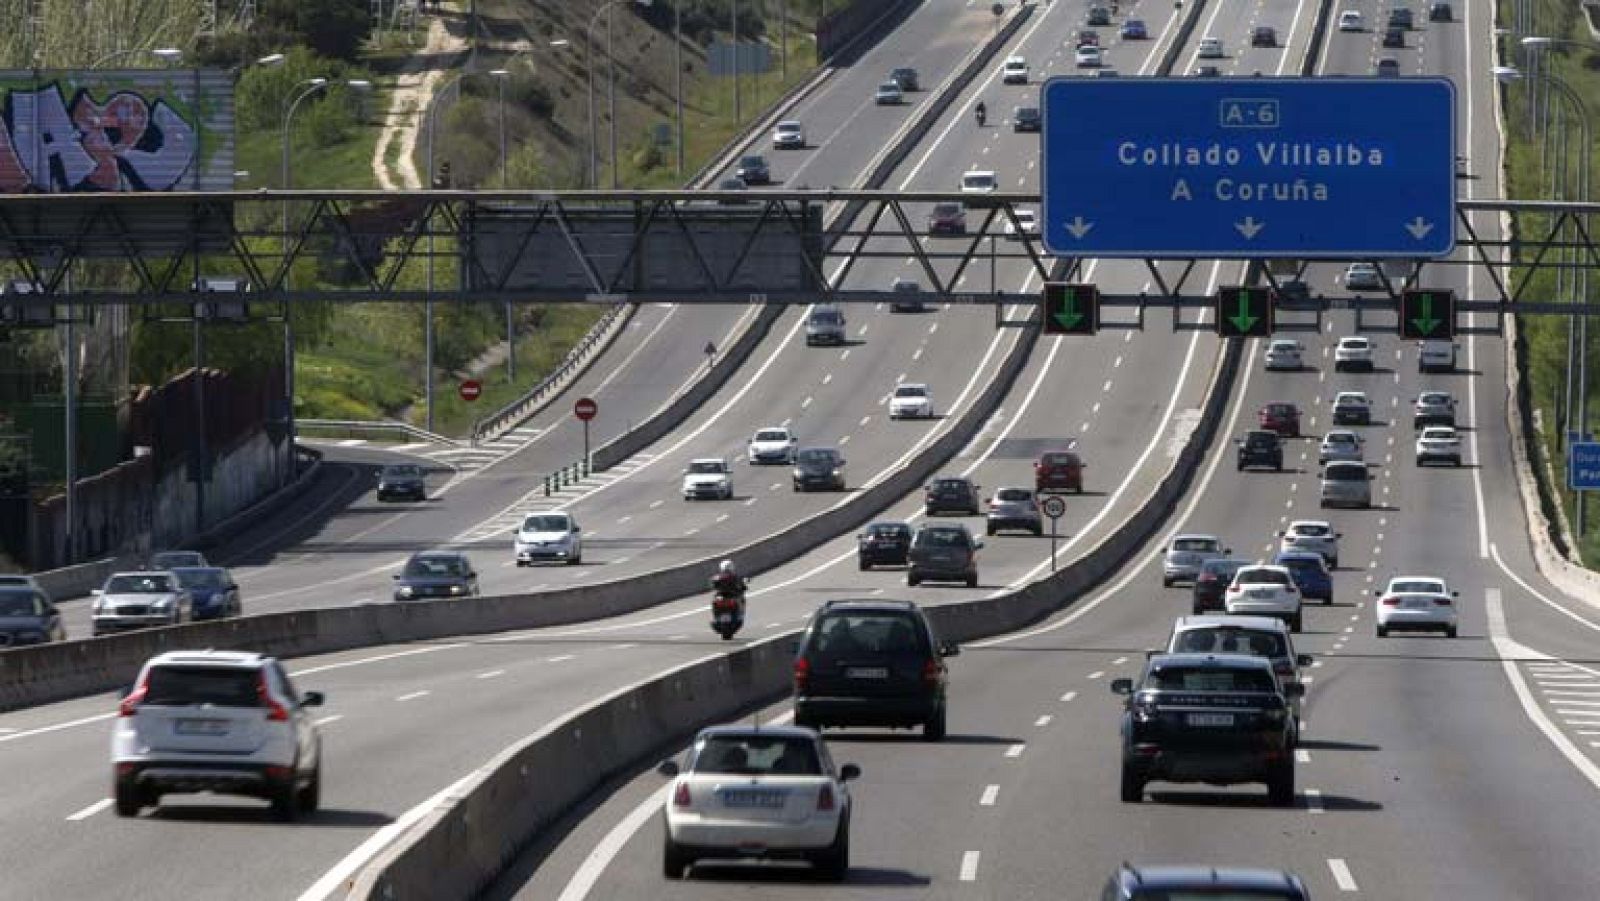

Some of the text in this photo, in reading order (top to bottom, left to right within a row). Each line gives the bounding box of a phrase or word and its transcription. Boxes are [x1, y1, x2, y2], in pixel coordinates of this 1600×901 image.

[1226, 103, 1274, 122] A-6
[1118, 141, 1383, 165] Collado Villalba
[1171, 178, 1328, 201] A Coruña
